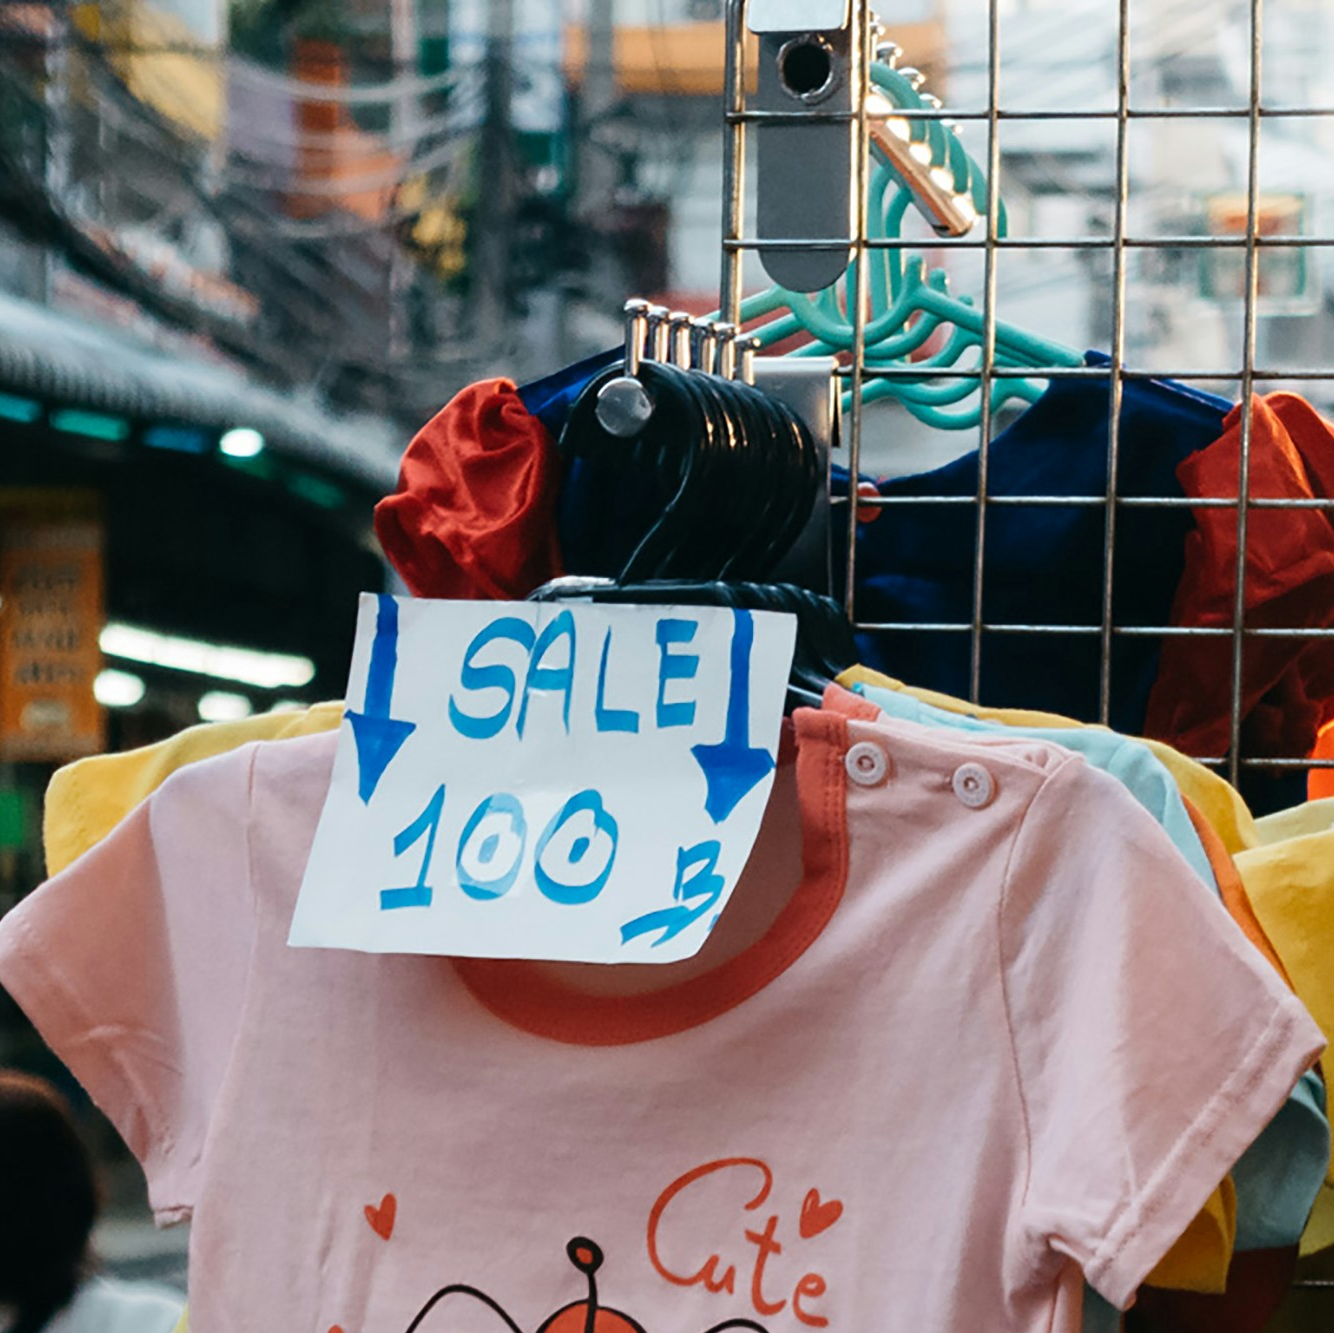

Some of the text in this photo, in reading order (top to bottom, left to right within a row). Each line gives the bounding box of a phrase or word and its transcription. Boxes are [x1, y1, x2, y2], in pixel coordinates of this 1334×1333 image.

[448, 609, 698, 741] SALE
[379, 783, 619, 912] 100
[647, 1157, 830, 1329] Cute
